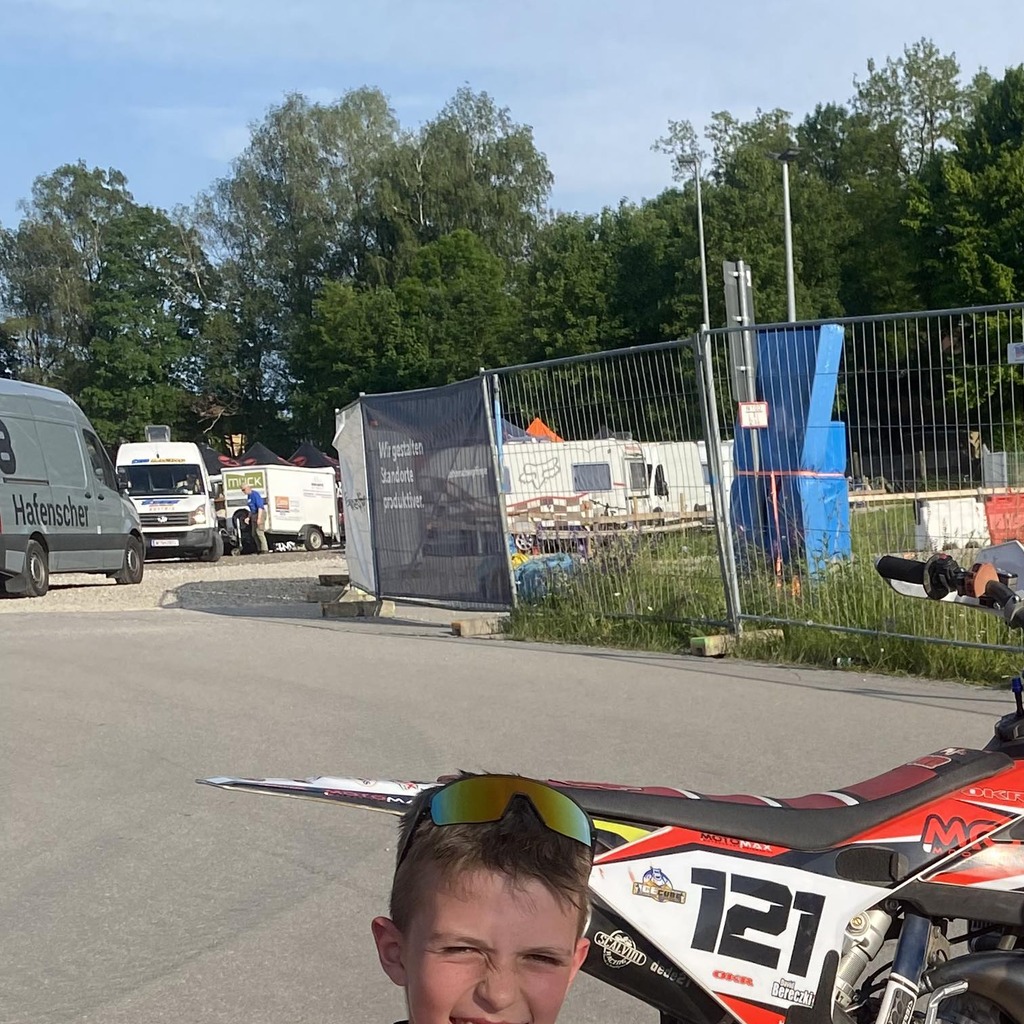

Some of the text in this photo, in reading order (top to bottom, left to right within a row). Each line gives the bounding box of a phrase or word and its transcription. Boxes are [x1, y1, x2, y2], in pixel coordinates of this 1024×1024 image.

[378, 439, 424, 461] Wir gestalten
[380, 466, 414, 484] Standorte
[12, 492, 89, 527] Hafenscher
[700, 832, 772, 852] MOTOMAX
[689, 867, 826, 978] 121
[598, 934, 644, 965] SCALVINI
[712, 969, 754, 987] OKR
[771, 981, 816, 1007] Bereczki
